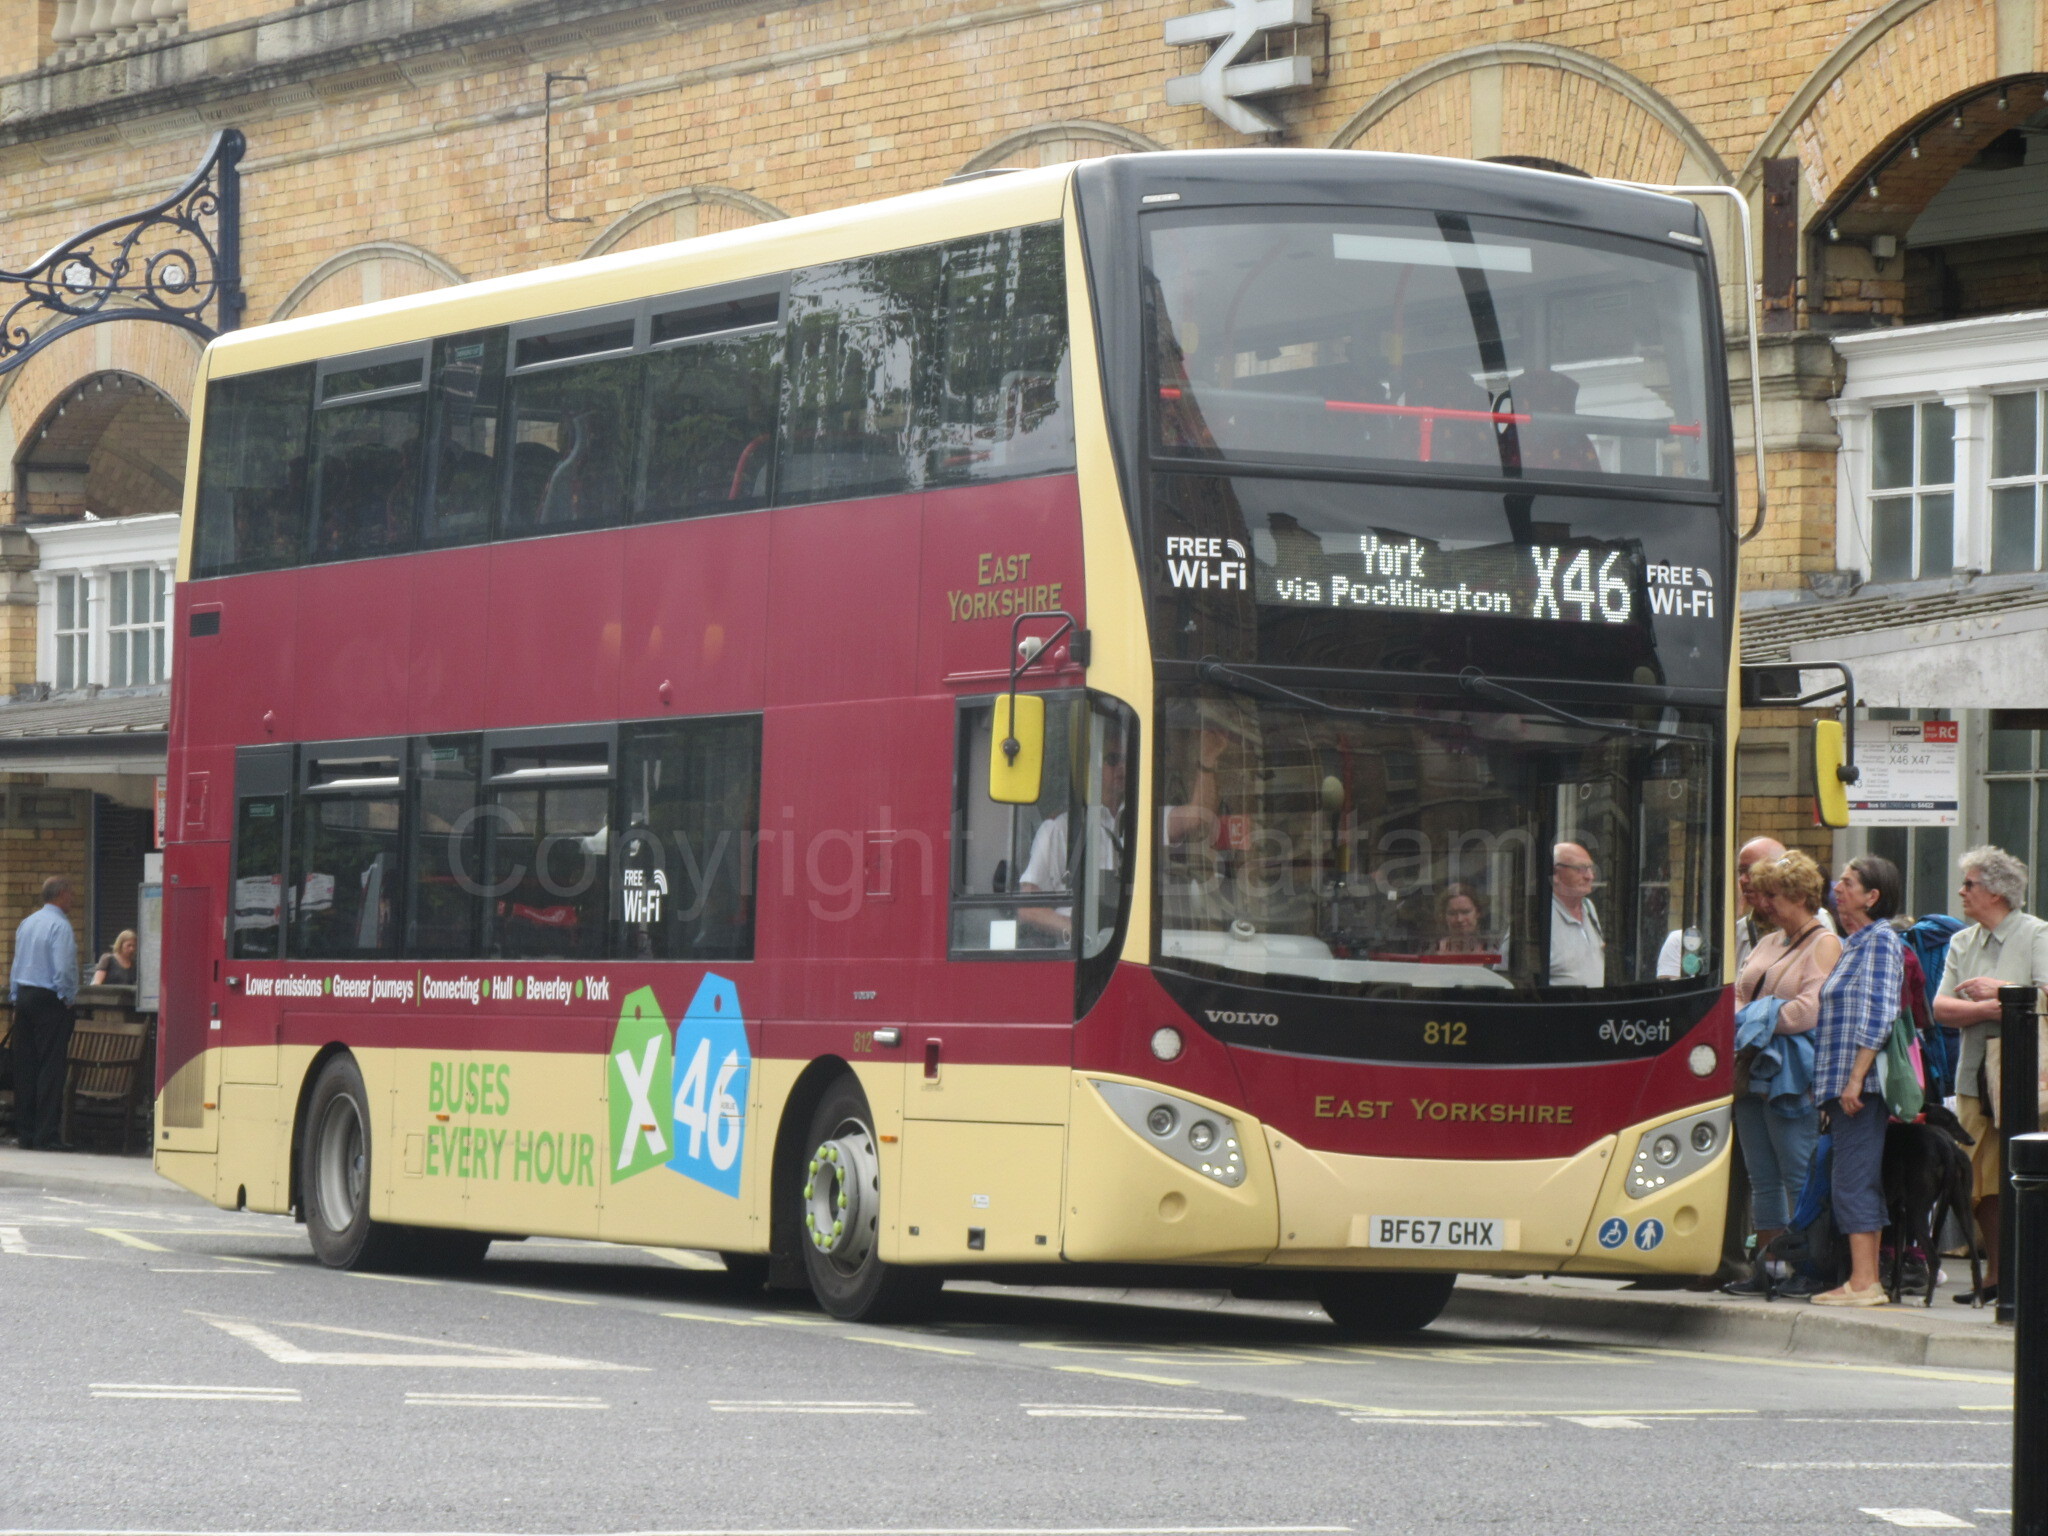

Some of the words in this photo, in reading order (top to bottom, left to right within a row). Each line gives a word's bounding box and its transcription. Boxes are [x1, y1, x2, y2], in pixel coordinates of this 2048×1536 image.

[1167, 536, 1221, 558] FREE
[1360, 536, 1426, 578] York
[978, 552, 1031, 586] EAST
[1168, 560, 1247, 590] Wi-Fi
[1647, 564, 1693, 586] FREE
[1277, 577, 1320, 602] via
[1332, 575, 1512, 613] Pocklington
[1531, 546, 1631, 624] X46
[947, 582, 1063, 622] YORKSHIRE
[1647, 587, 1714, 619] Wi-Fi
[1939, 726, 1956, 738] RC
[1889, 755, 1908, 765] X46
[1911, 755, 1930, 765] X47
[624, 869, 643, 886] FREE
[623, 889, 660, 922] Wi-Fi
[245, 973, 272, 996] Lower
[274, 975, 322, 997] emissions
[333, 975, 371, 998] Greener
[371, 975, 413, 1002] journeys
[423, 976, 479, 1004] Connecting
[492, 976, 512, 1000] Hull
[526, 976, 572, 1005] Beverley
[586, 976, 609, 1001] York
[1205, 1010, 1279, 1026] VOLVO
[1423, 1021, 1468, 1046] 812
[853, 1031, 872, 1053] 812
[428, 1061, 510, 1116] BUSES
[615, 1034, 667, 1171] X
[673, 1037, 740, 1171] 46
[1314, 1095, 1393, 1119] EAST
[1409, 1098, 1573, 1124] YORKSHIRE
[426, 1125, 507, 1178] EVERY
[513, 1130, 594, 1187] HOUR
[1380, 1219, 1441, 1244] BF67
[1448, 1221, 1494, 1246] GHX
